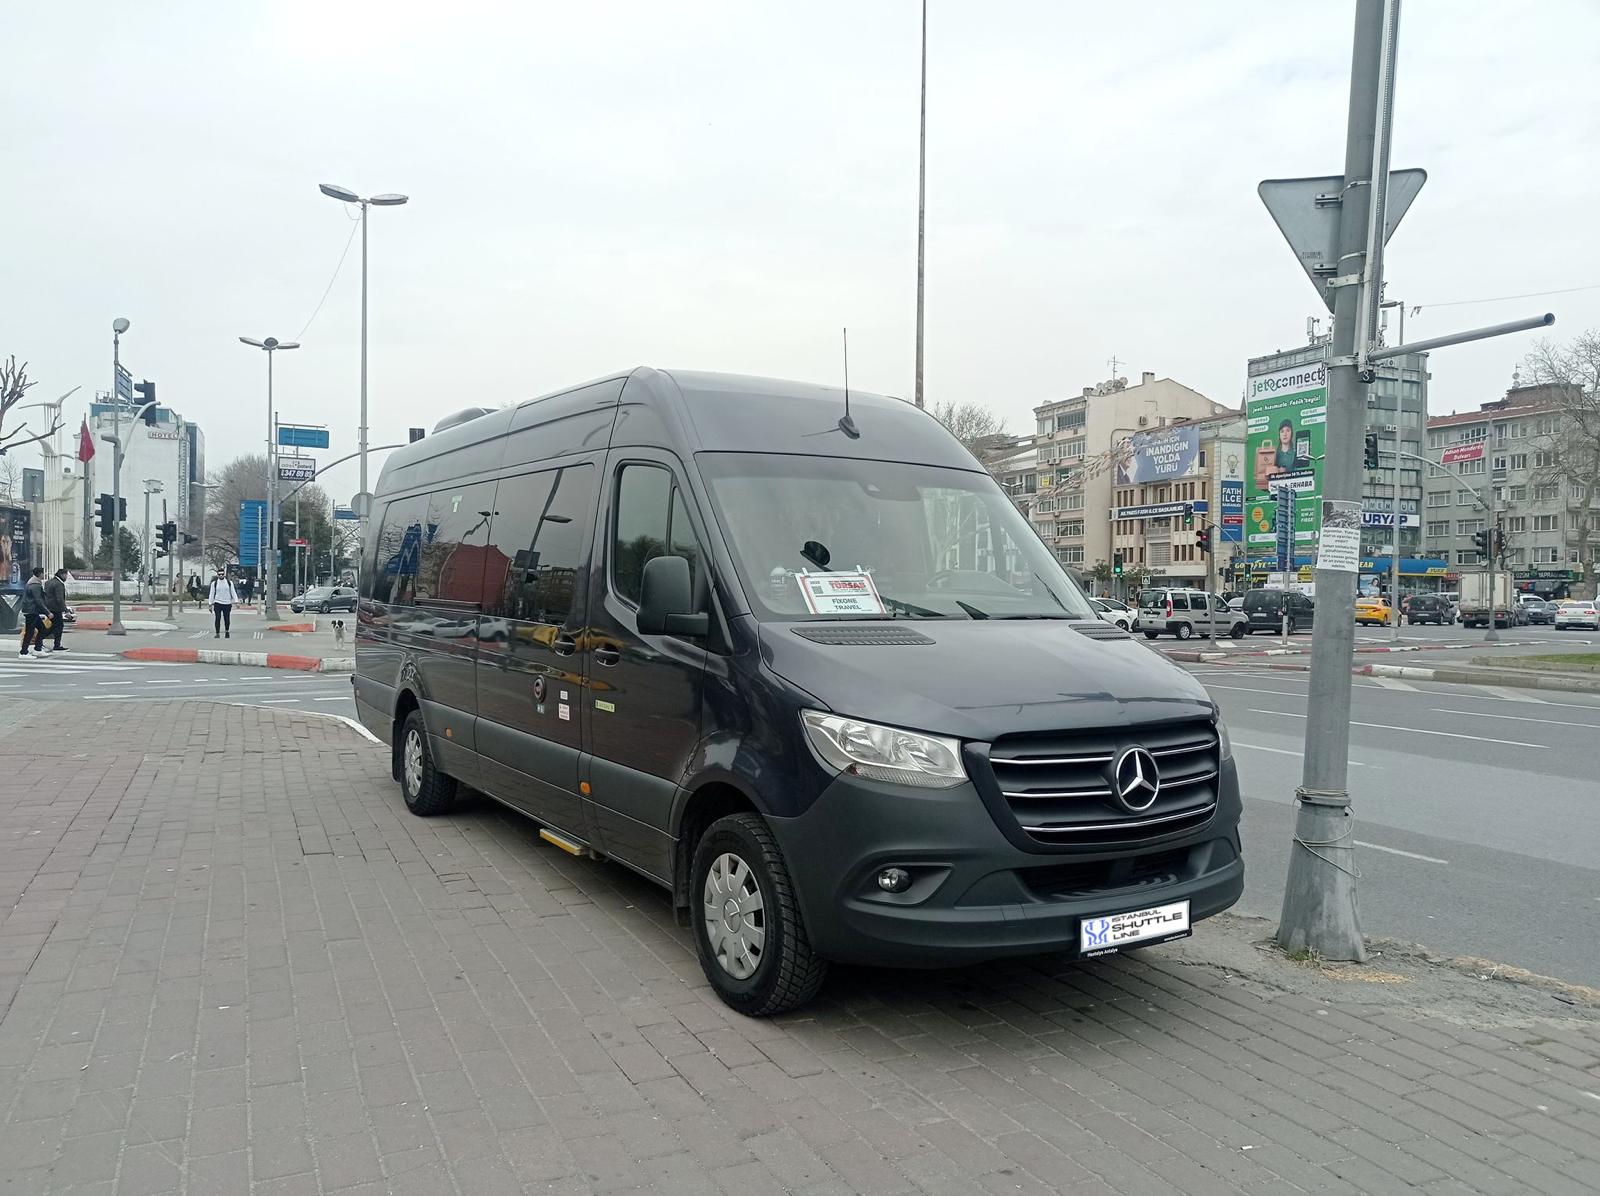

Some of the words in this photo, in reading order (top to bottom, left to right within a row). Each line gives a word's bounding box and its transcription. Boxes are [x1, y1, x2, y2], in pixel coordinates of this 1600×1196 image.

[151, 431, 177, 439] HOTEL
[1153, 453, 1181, 464] YOLDA
[1112, 912, 1182, 932] SHUTTLE
[1113, 930, 1140, 940] LINE
